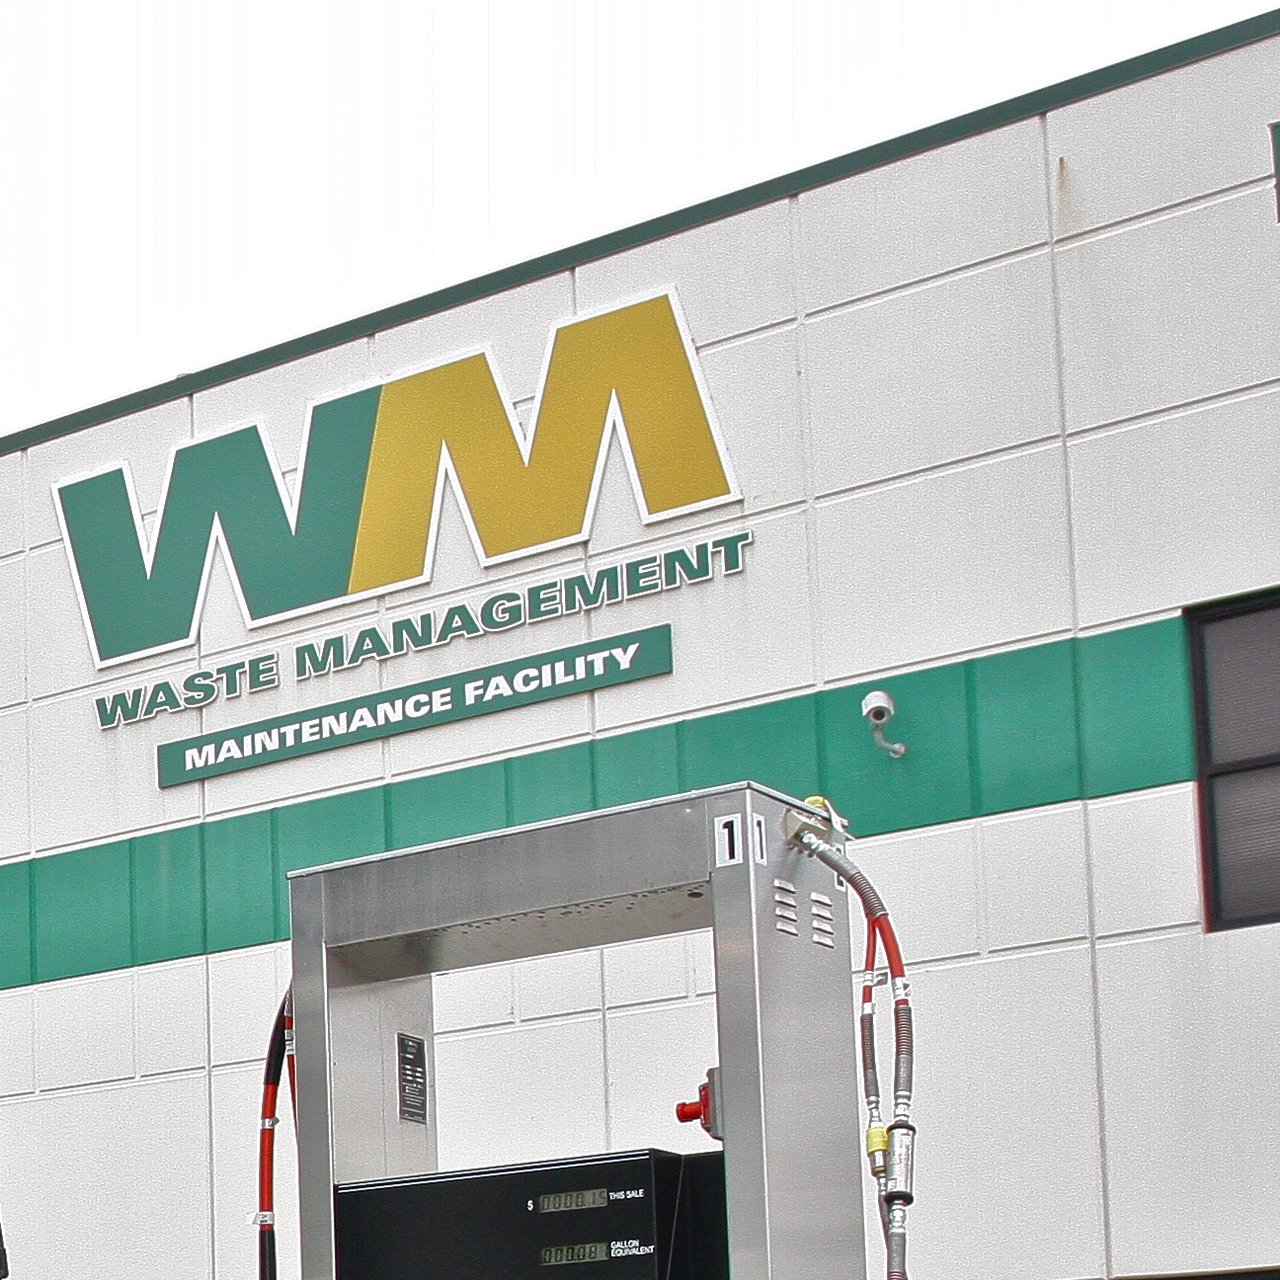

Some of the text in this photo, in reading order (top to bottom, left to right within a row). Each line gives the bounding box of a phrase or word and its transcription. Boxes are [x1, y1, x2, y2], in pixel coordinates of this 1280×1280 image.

[55, 291, 736, 665] WM
[95, 531, 753, 729] WASTE MANAGEMENT
[183, 643, 640, 771] MAINTENANCE FACILITY
[722, 819, 736, 861] 1
[526, 1199, 534, 1211] $
[609, 1191, 625, 1201] THIS
[626, 1188, 645, 1199] SALE
[610, 1239, 640, 1249] GALLON
[610, 1245, 655, 1258] EQUIVALENT
